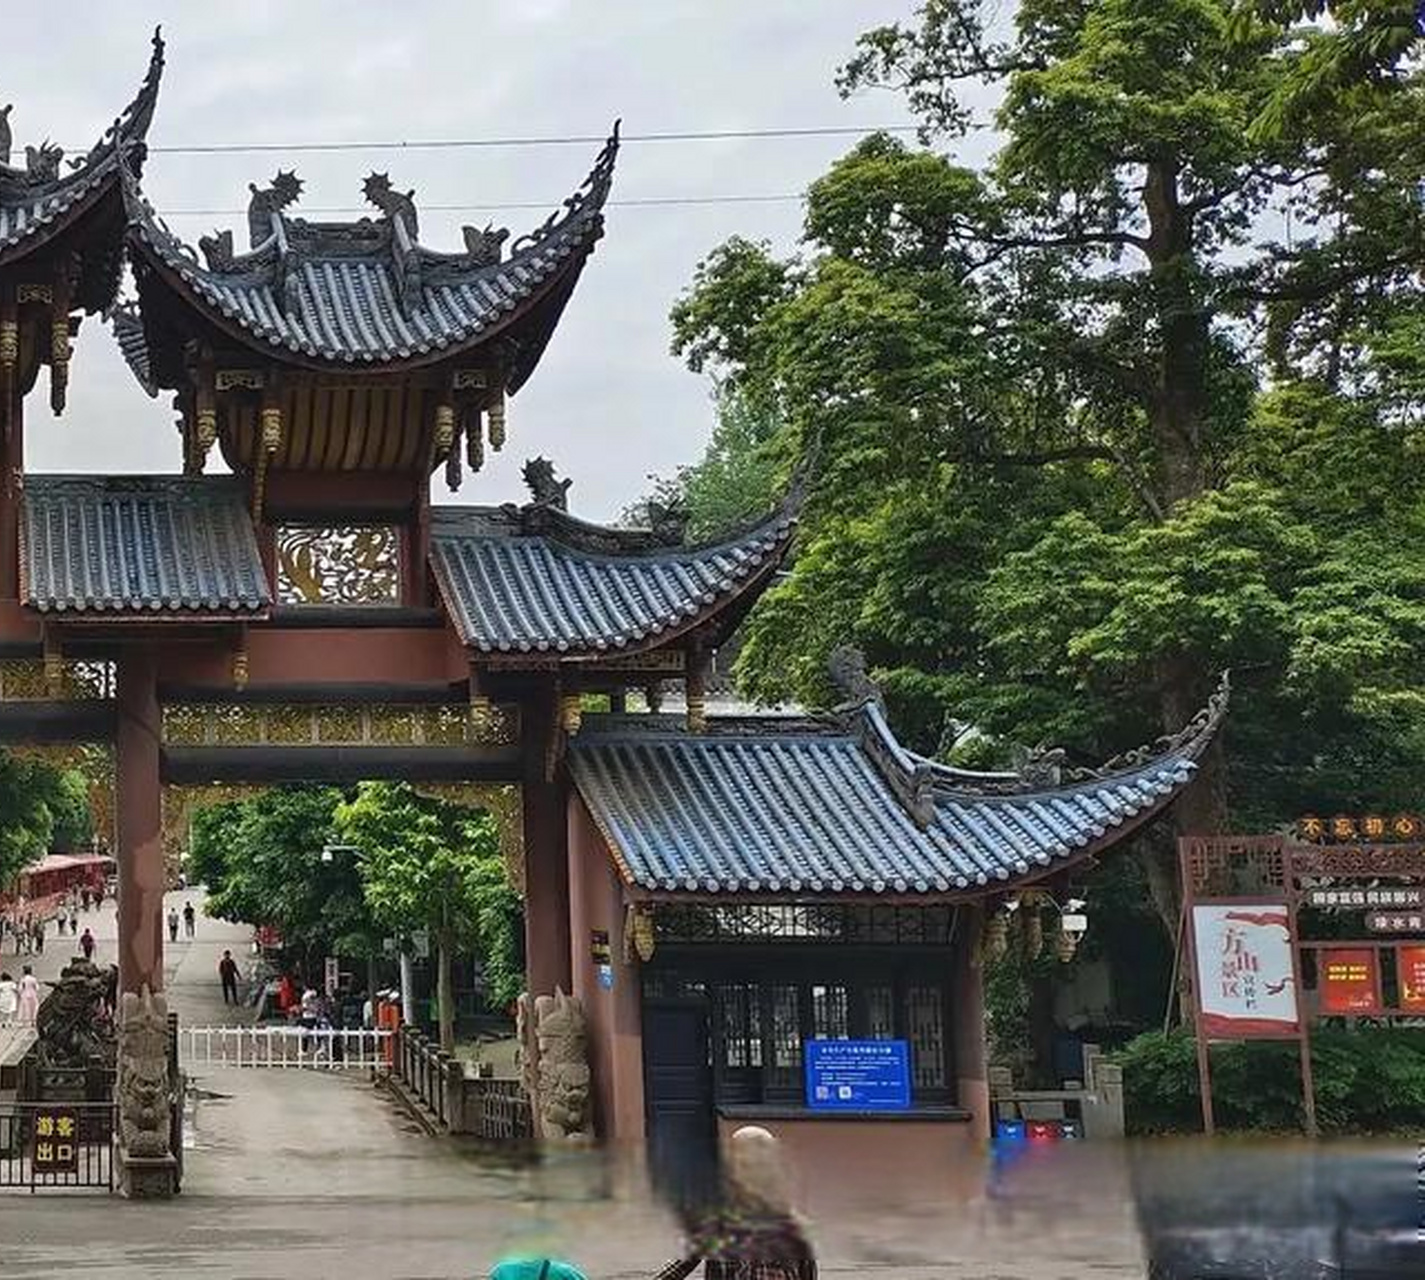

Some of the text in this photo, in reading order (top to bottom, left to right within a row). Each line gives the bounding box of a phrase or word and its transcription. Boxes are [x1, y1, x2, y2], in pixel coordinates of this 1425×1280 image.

[1301, 816, 1414, 835] 不忘初心
[36, 1116, 75, 1137] 游客
[37, 1143, 73, 1161] 出口
